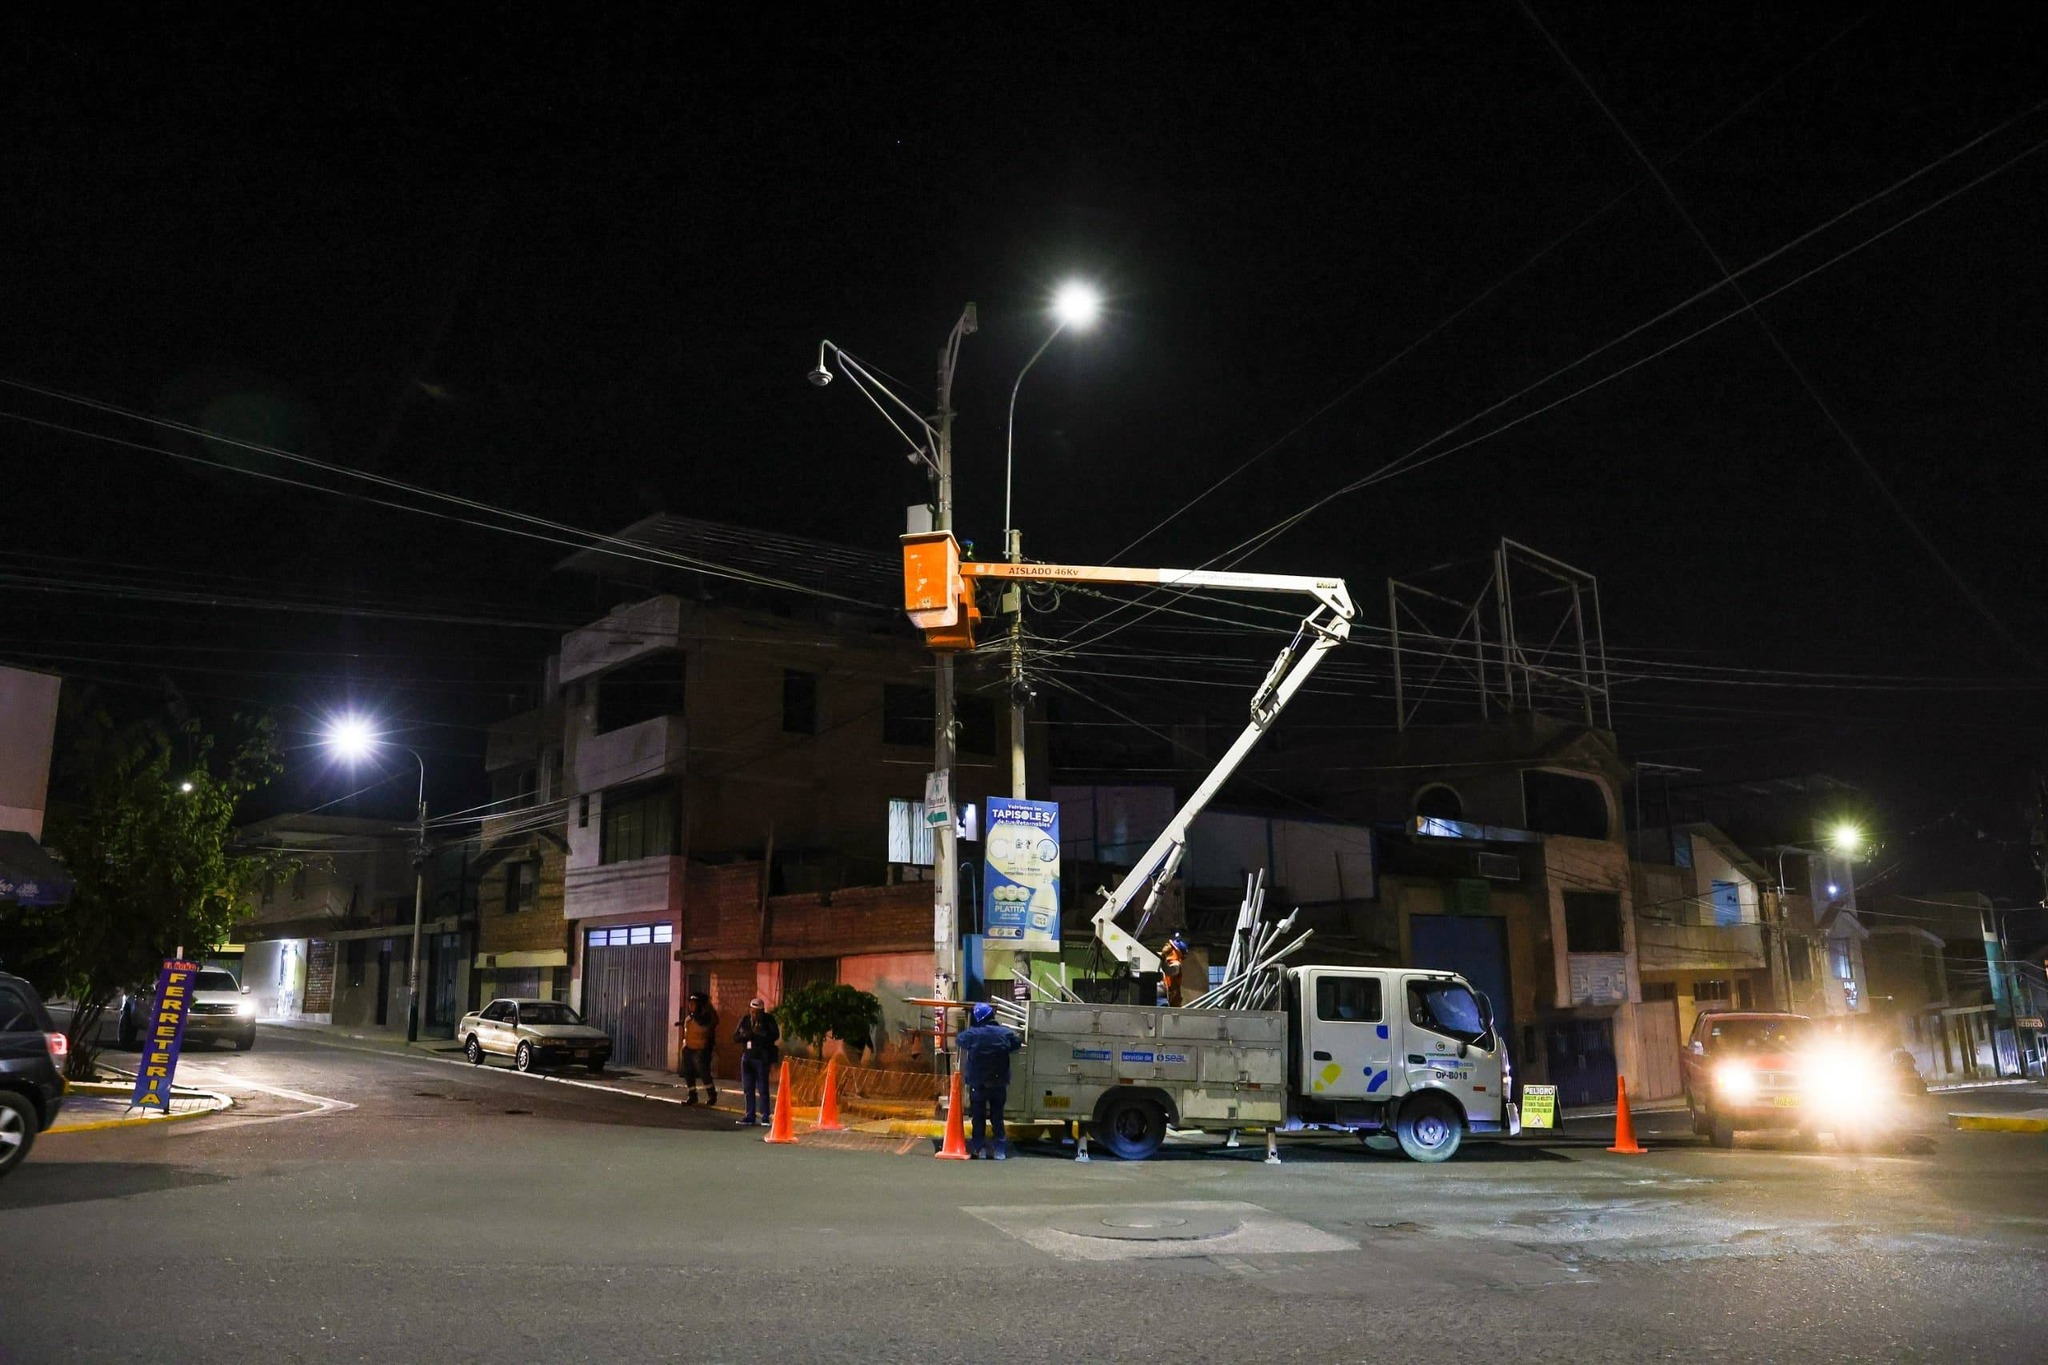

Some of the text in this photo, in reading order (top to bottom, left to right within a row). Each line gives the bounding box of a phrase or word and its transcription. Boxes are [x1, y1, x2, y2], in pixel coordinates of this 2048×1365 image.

[1008, 567, 1079, 576] AISLADO 46Kv
[1015, 819, 1050, 828] Retornables
[994, 905, 1026, 913] PLATITA
[139, 973, 187, 1104] FERRETERIA
[1122, 1053, 1143, 1061] servicio
[1435, 1071, 1468, 1080] OP-B018
[1525, 1087, 1553, 1095] PELIGRO
